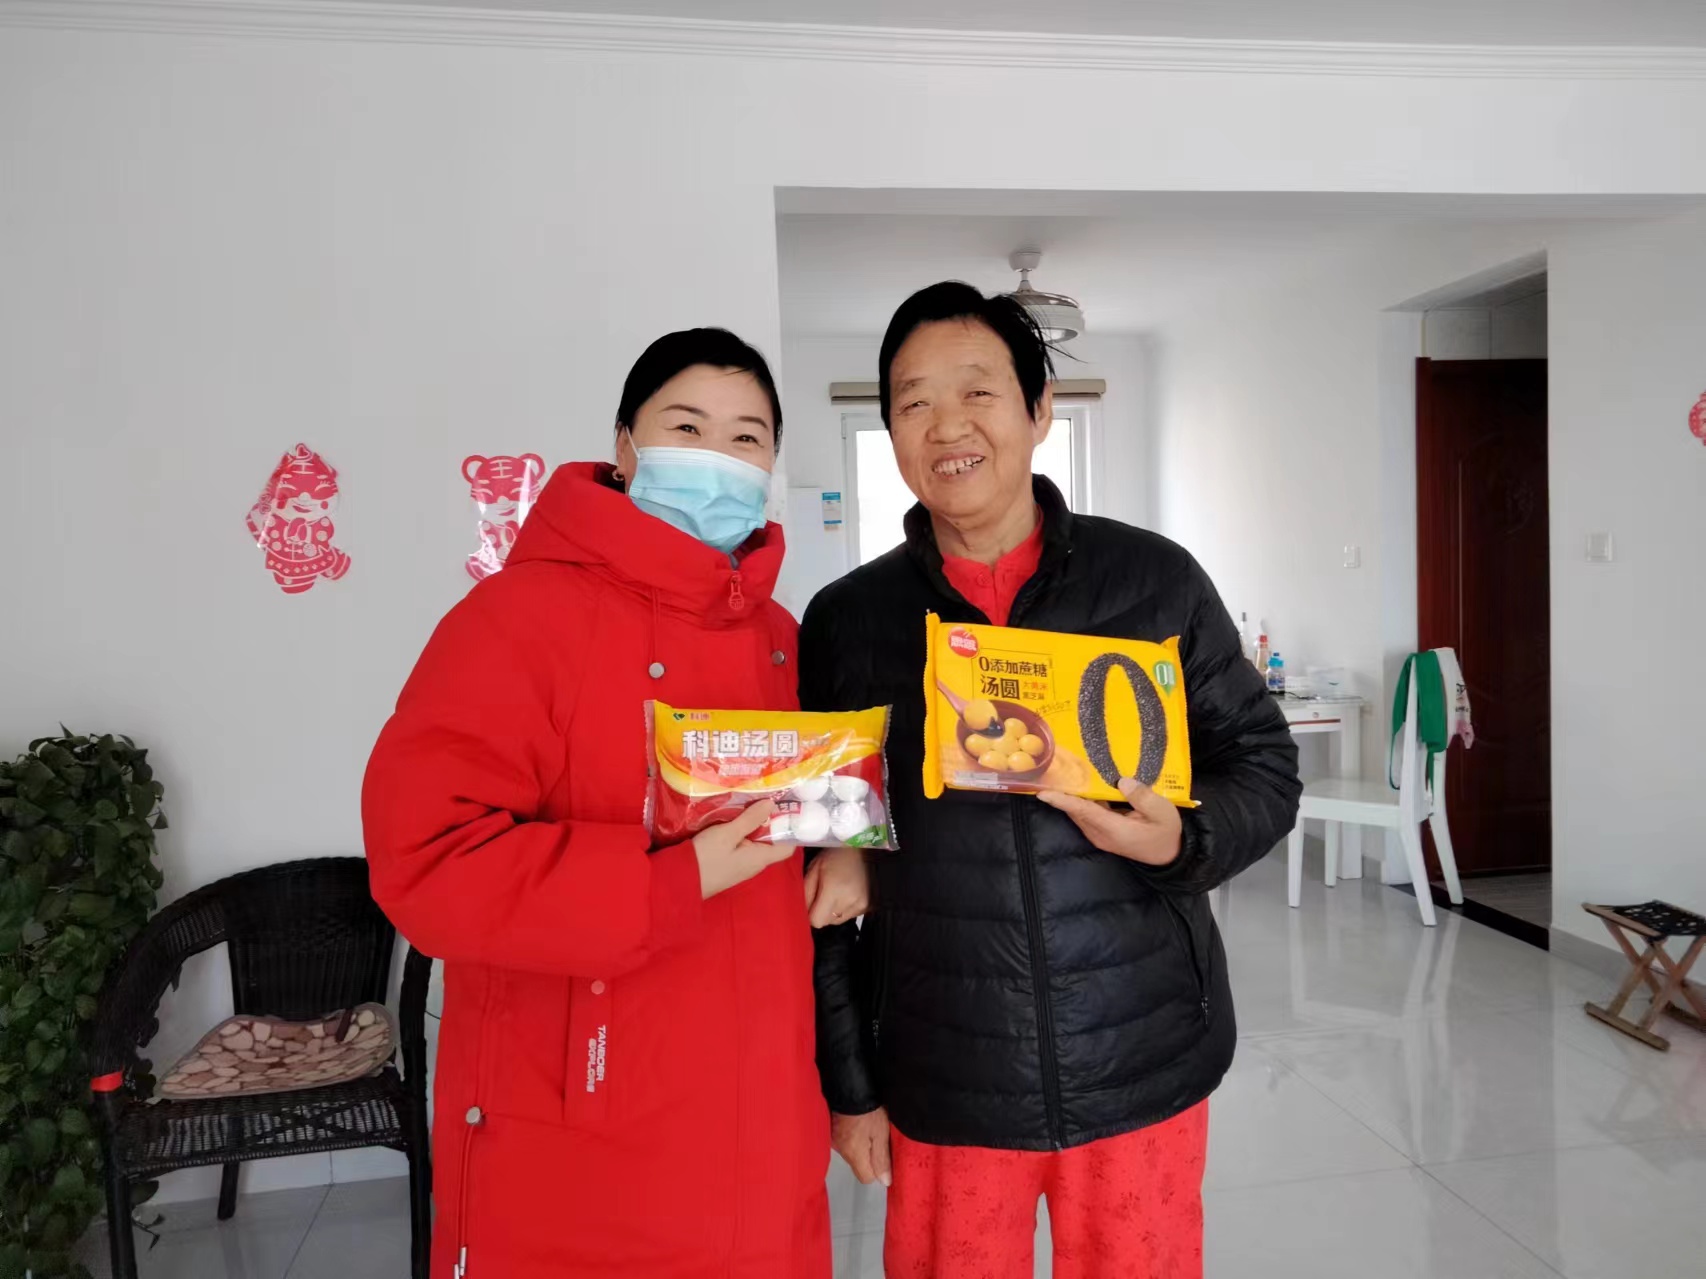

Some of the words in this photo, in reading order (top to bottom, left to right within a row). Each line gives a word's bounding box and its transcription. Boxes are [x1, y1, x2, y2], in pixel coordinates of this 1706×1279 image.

[979, 656, 1048, 678] 0添加蔗糖
[980, 674, 1020, 700] 汤圆
[682, 729, 799, 758] 科迪汤圆
[597, 1025, 606, 1081] TANBOER
